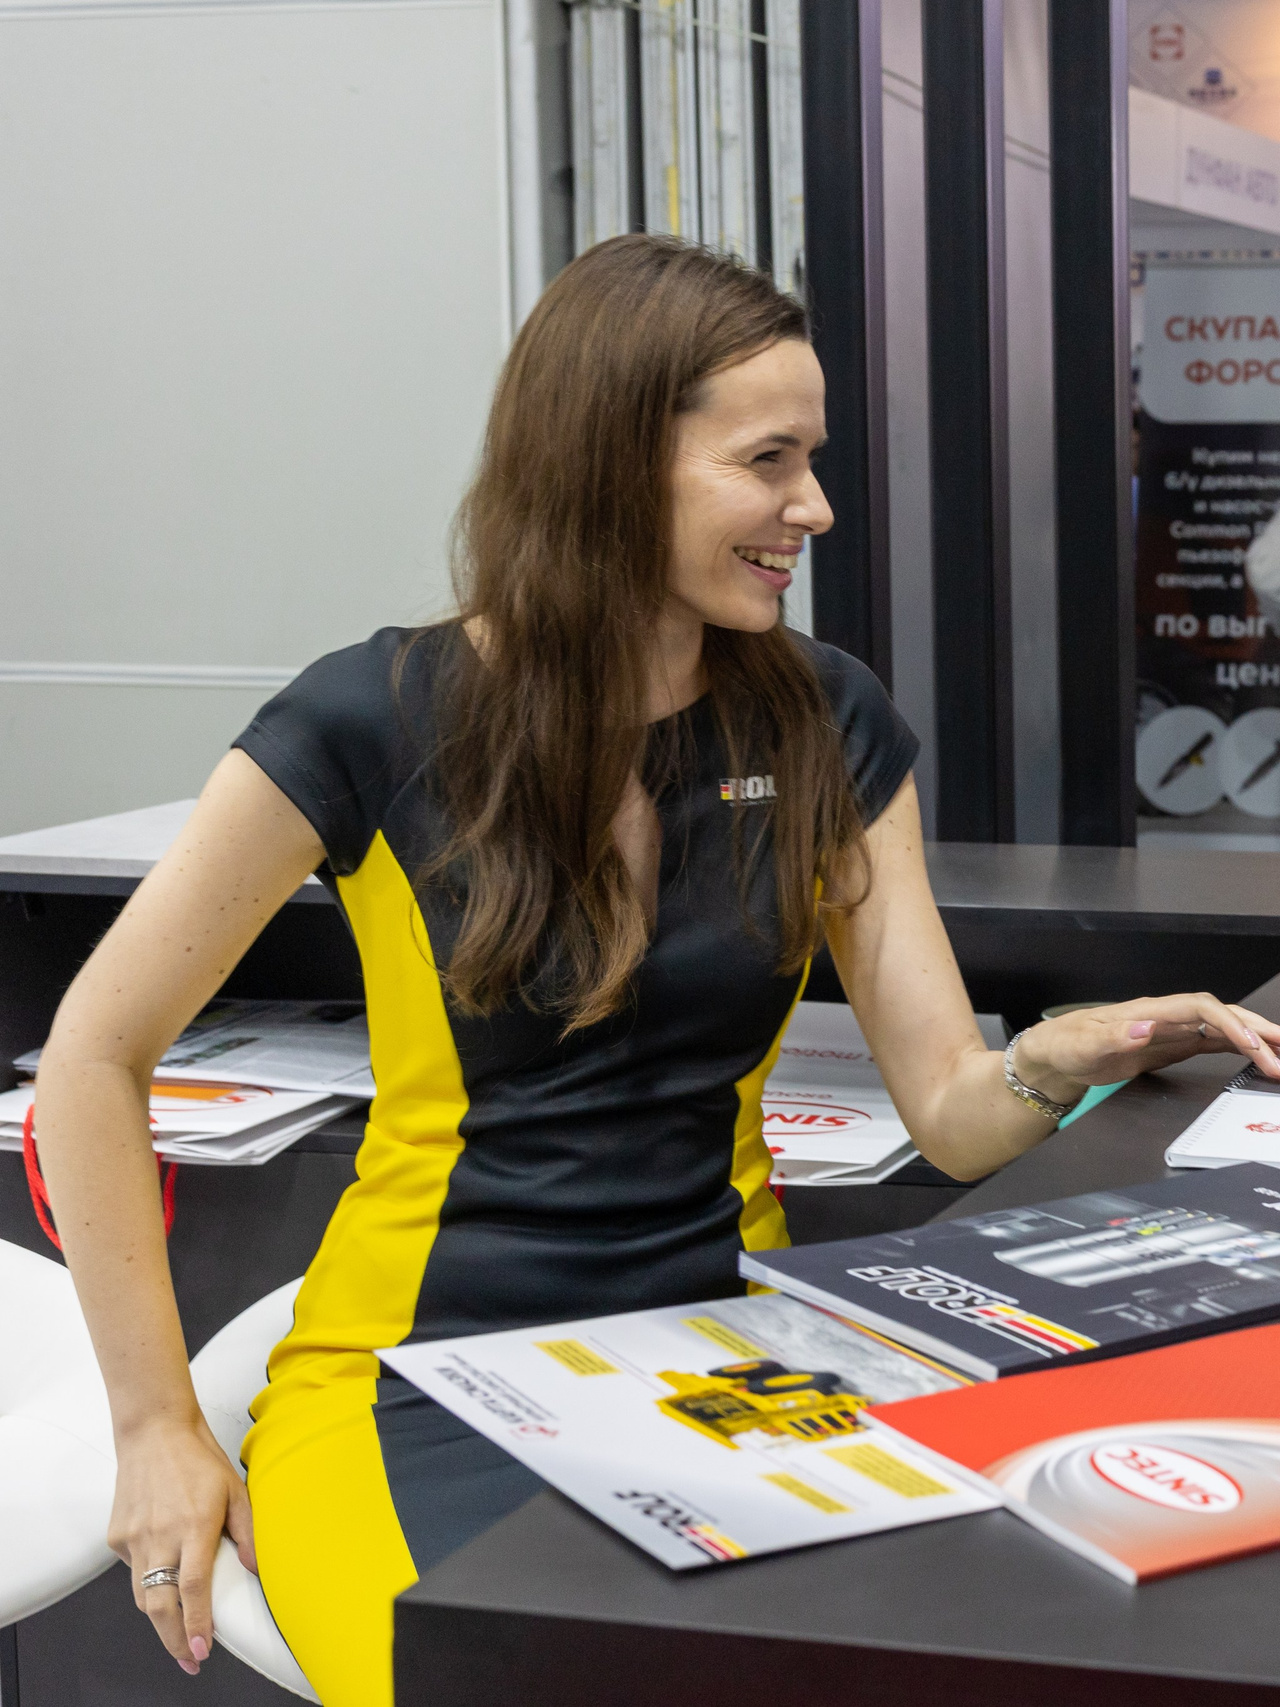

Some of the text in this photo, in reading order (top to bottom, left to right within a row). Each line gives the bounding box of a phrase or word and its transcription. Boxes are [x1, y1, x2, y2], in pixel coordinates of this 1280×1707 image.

[1169, 520, 1250, 538] Common
[1155, 614, 1270, 638] по выг
[846, 1265, 1020, 1325] ROLF
[1105, 1448, 1226, 1505] SINTEC
[613, 1491, 716, 1538] ROLF
